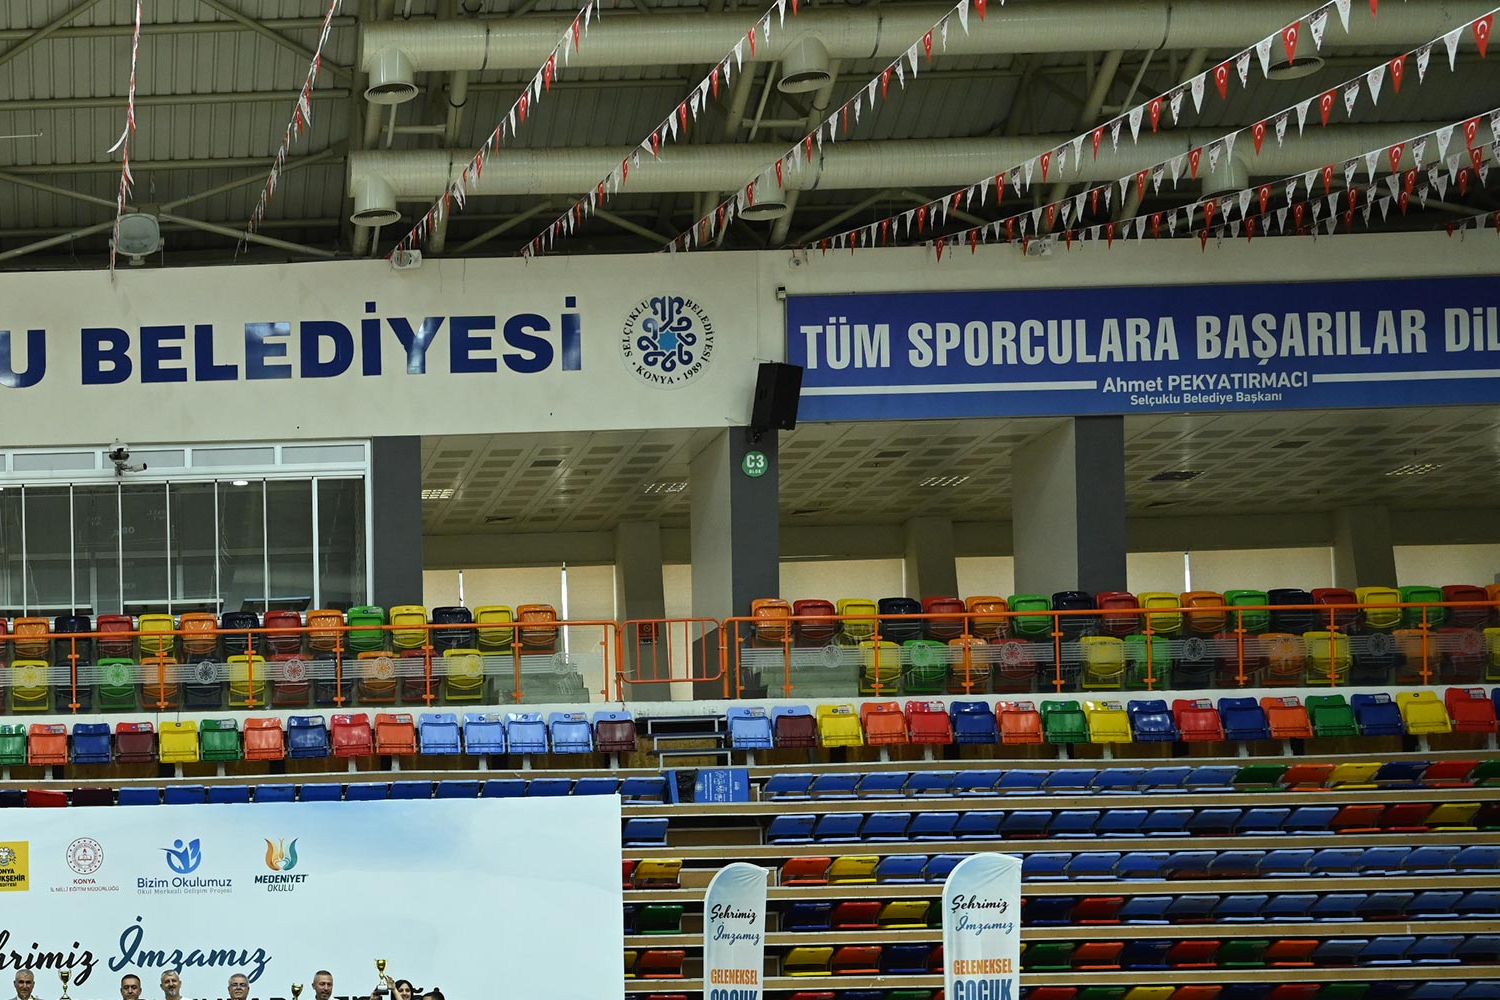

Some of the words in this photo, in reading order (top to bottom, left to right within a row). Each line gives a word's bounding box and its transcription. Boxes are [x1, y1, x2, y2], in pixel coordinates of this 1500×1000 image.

[622, 299, 650, 358] SELÇUKLU
[800, 316, 891, 369] TÜM
[908, 316, 1180, 368] SPORCULARA
[1196, 309, 1428, 366] BAŞARILAR
[80, 296, 583, 385] BELEDİYESİ
[635, 365, 675, 384] KONYA
[682, 362, 703, 380] 1989
[1102, 376, 1163, 394] Ahmet
[1167, 371, 1308, 392] PEKYATIRMACI
[1130, 394, 1181, 406] Selçuklu
[1183, 393, 1233, 405] Belediye
[1235, 391, 1283, 403] Başkanı
[746, 454, 765, 468] C3
[137, 877, 169, 888] Bizim
[171, 876, 233, 888] Okulumuz
[254, 874, 307, 884] MEDENİYET
[267, 884, 295, 892] OKULU
[711, 904, 758, 925] Şehrimiz
[951, 894, 1009, 914] Şehrimiz
[713, 922, 761, 946] İmzamız
[955, 912, 1016, 936] İmzamız
[107, 915, 272, 984] İmzamız
[710, 968, 758, 986] GELENEKSEL
[953, 958, 1013, 976] GELENEKSEL
